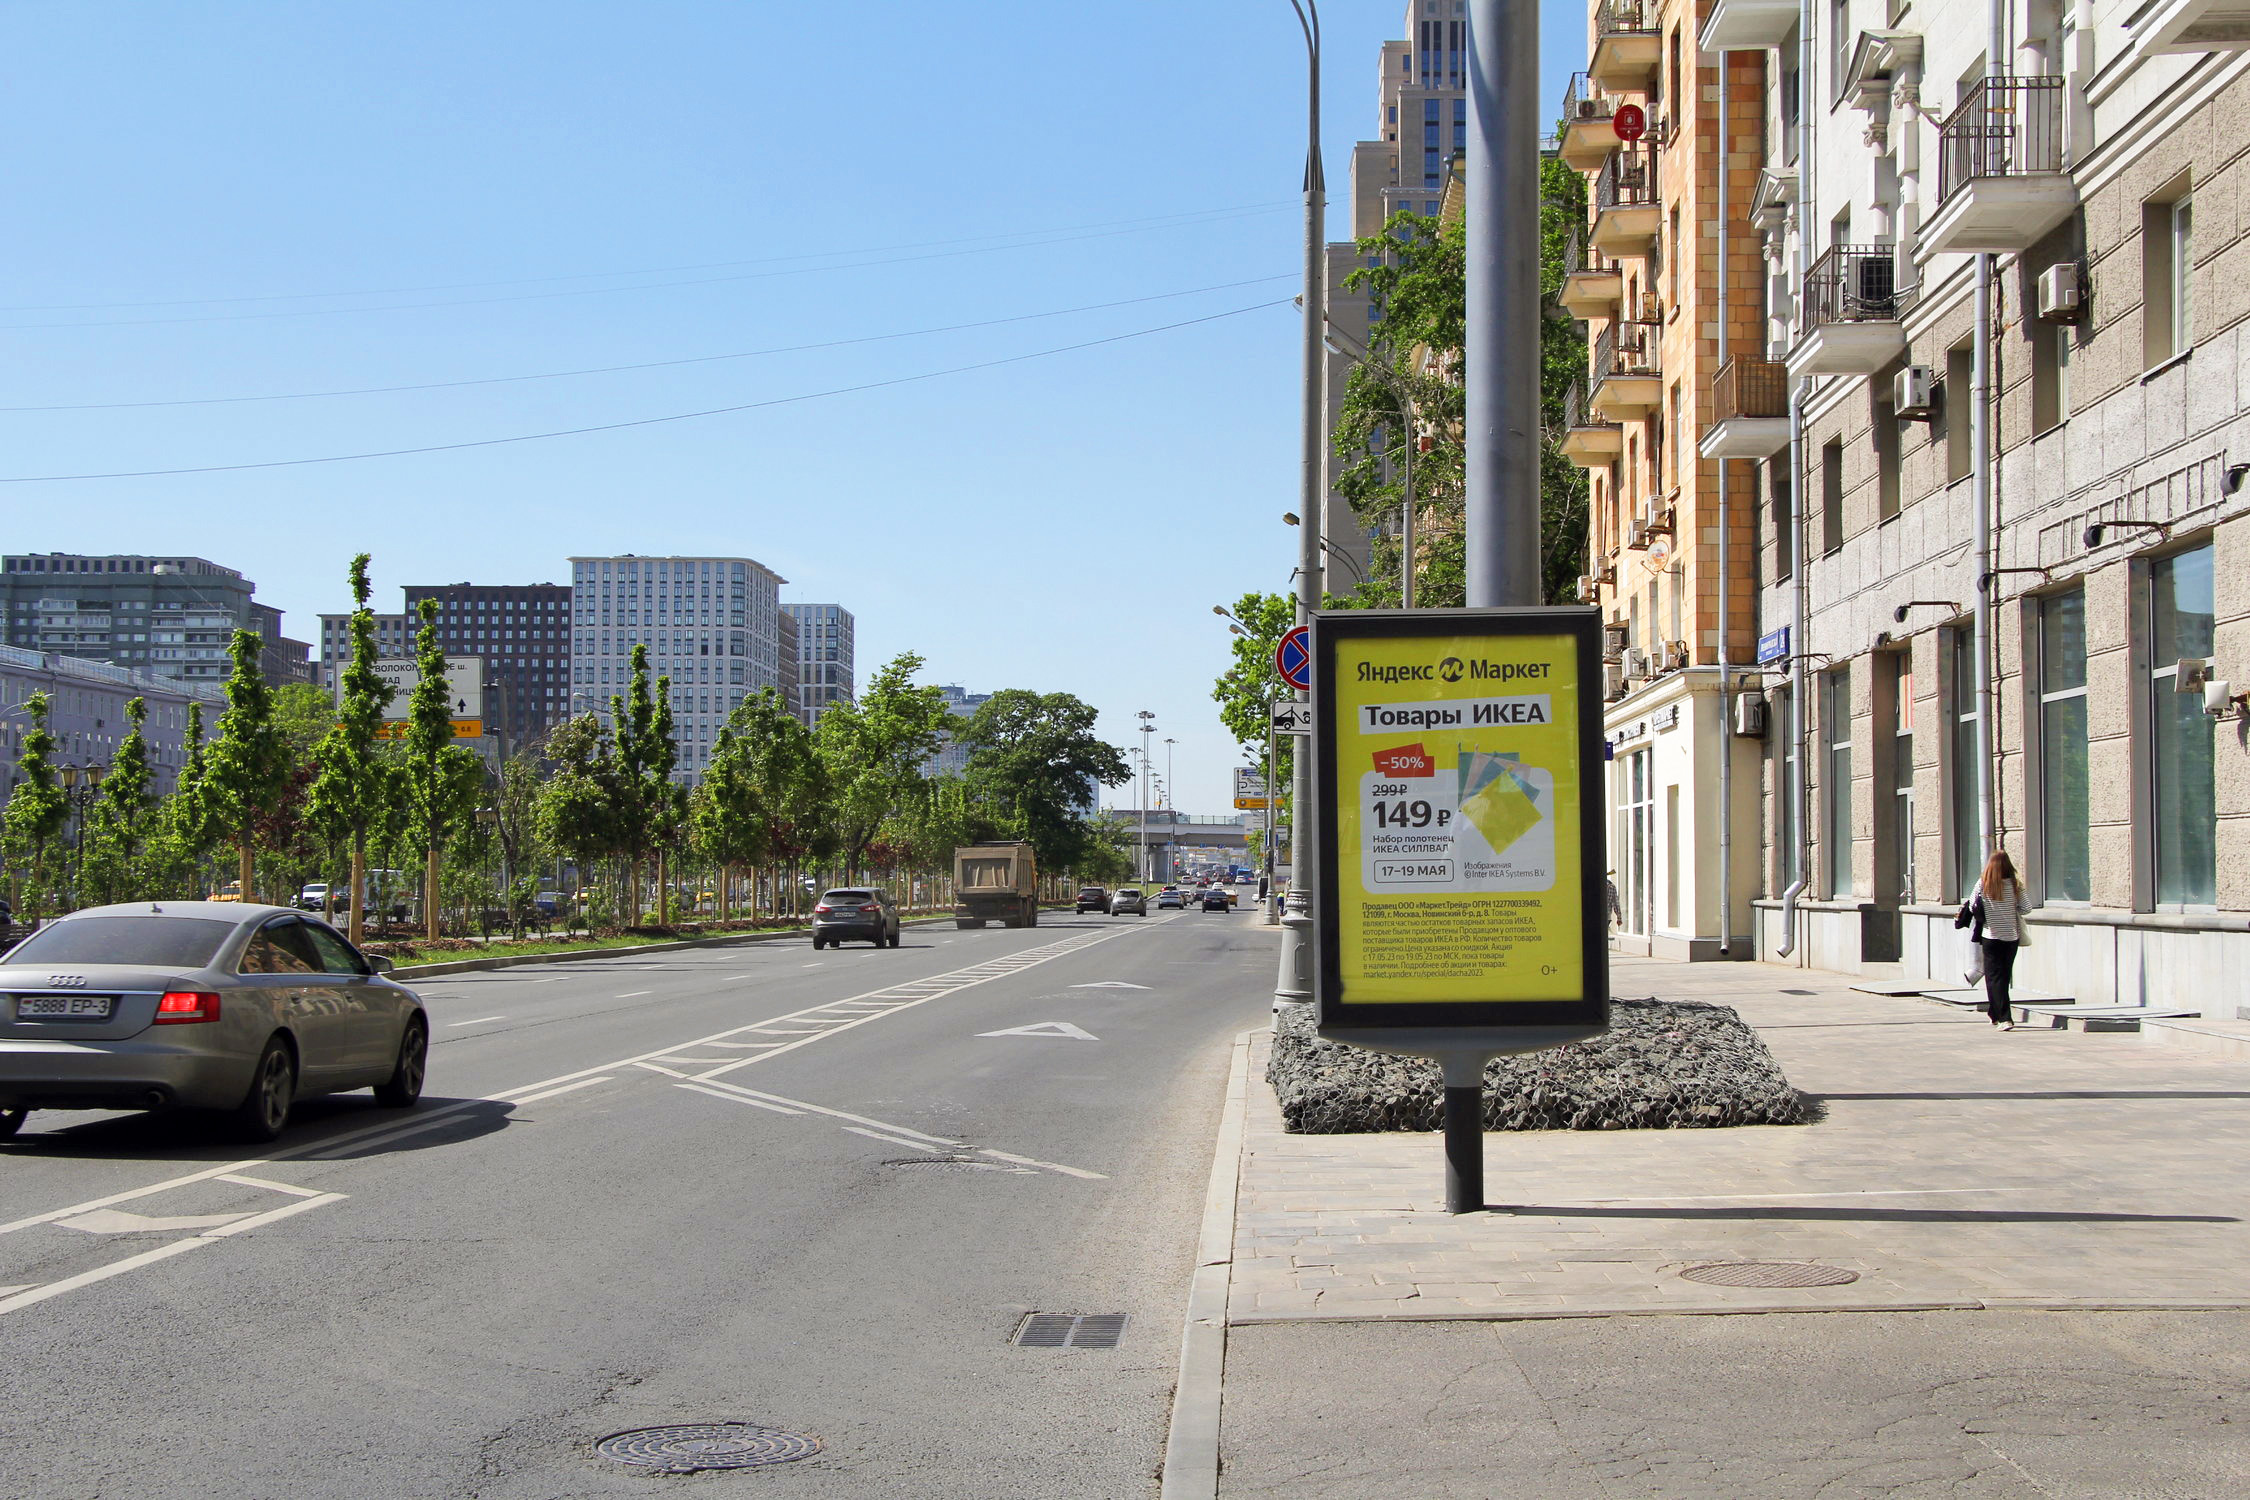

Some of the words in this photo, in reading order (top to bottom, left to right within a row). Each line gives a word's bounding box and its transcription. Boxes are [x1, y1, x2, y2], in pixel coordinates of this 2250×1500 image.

[1357, 661, 1434, 684] Яндекс
[1470, 659, 1551, 682] Маркет
[1365, 706, 1461, 729] Товары
[1473, 703, 1545, 724] ИКЕА
[1380, 756, 1424, 769] -50%
[1373, 800, 1432, 828] 149
[1373, 835, 1402, 843] Набор
[1404, 834, 1454, 843] полотенец
[1373, 845, 1399, 853] ИКЕА
[1402, 844, 1449, 853] СИЛЛВАЛ
[1417, 865, 1446, 875] МАЯ
[1464, 862, 1511, 870] Изображения
[1489, 870, 1505, 878] IKEA
[1505, 869, 1533, 879] Systems
[1362, 902, 1397, 910] Продавец
[1472, 900, 1491, 908] ОГРН
[1422, 909, 1460, 917] Новинский
[1492, 909, 1516, 917] Товары
[1514, 917, 1536, 925] ИКЕА,
[1392, 927, 1410, 935] были
[1412, 927, 1458, 936] приобретены
[1459, 926, 1498, 934] Продавцом
[1405, 936, 1433, 944] товаров
[1473, 934, 1512, 942] Количество
[1424, 944, 1450, 952] указана
[1491, 943, 1512, 951] Акция
[1368, 953, 1395, 961] 17.05.23
[1400, 961, 1439, 970] Подробнее
[1450, 961, 1471, 969] акции
[32, 999, 67, 1012] 5888
[71, 999, 109, 1013] EP-3
